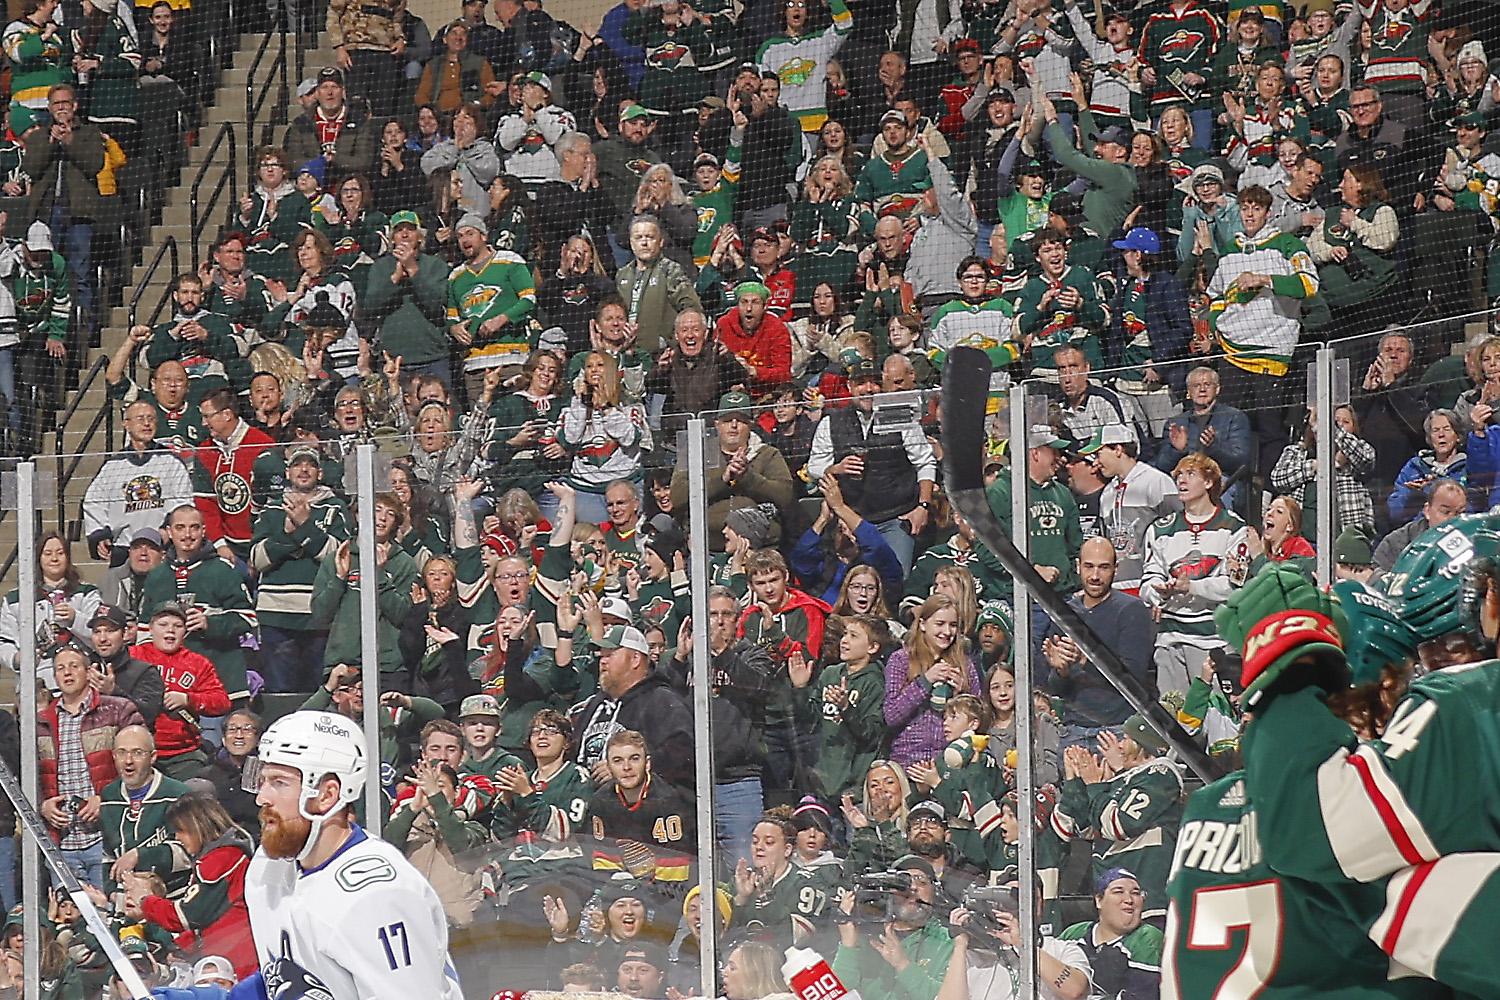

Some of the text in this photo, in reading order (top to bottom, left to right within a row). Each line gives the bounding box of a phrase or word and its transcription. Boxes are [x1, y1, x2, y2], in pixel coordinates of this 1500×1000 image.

[313, 722, 350, 739] NexGen
[1120, 788, 1150, 820] 12
[652, 813, 682, 843] 40
[798, 886, 826, 917] 97
[377, 920, 412, 971] 17
